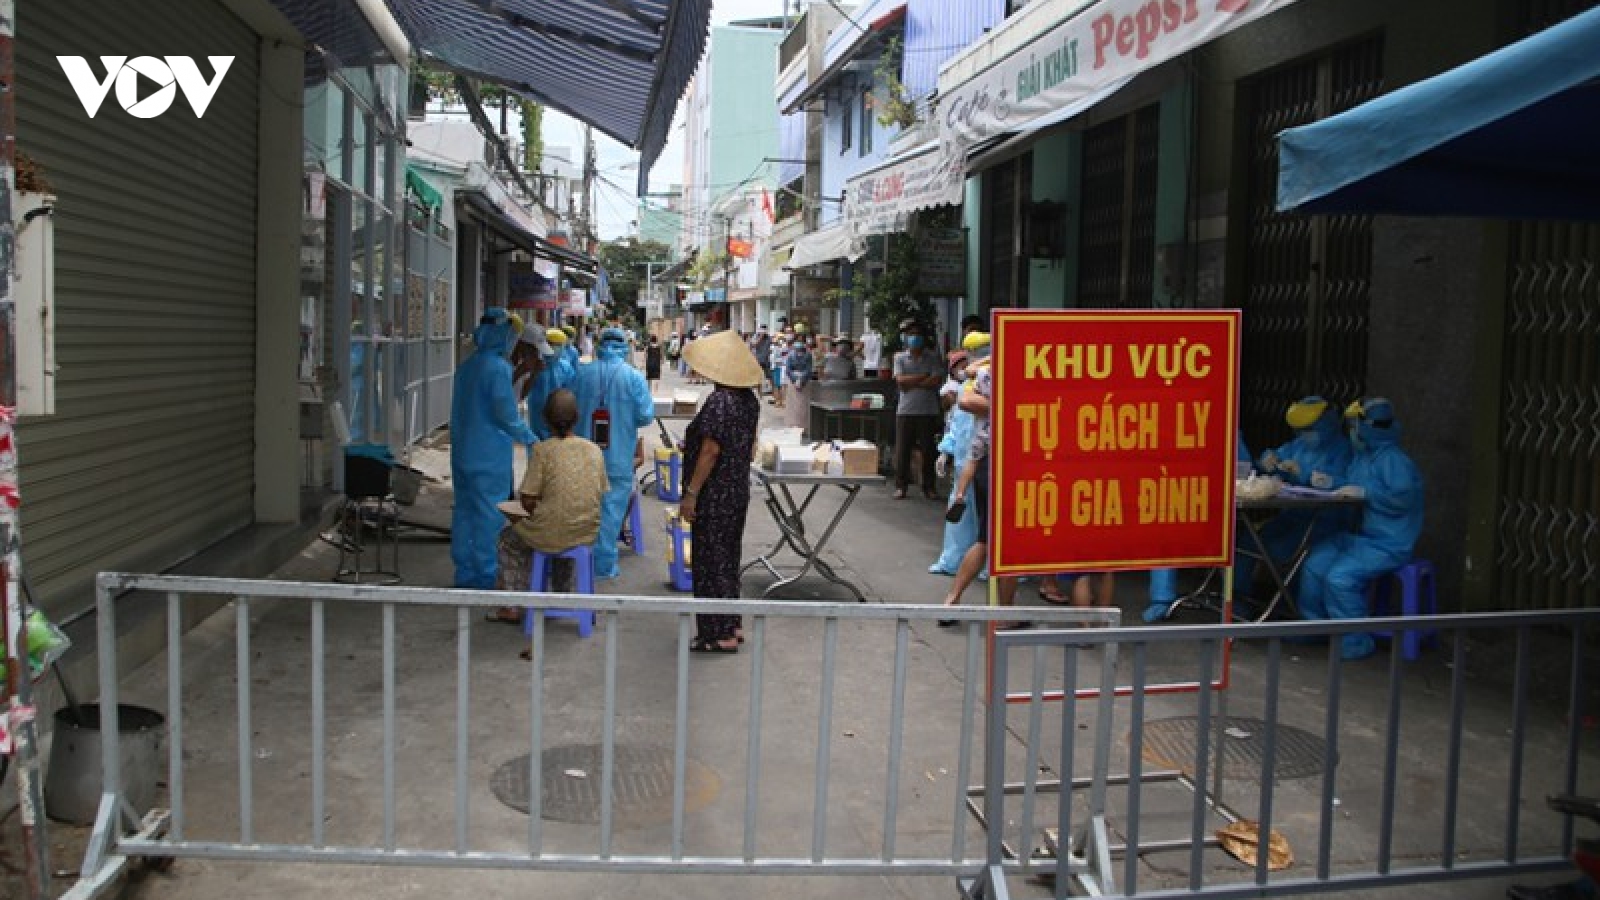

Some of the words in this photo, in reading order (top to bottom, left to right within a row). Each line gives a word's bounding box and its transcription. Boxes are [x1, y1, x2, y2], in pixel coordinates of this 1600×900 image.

[1023, 343, 1113, 380] KHU
[1127, 337, 1212, 386] VỰC
[1015, 396, 1062, 461] TỰ
[1077, 393, 1159, 451] CÁCH
[1175, 401, 1211, 449] LY
[1014, 471, 1060, 536] HỘ
[1071, 479, 1123, 527] GIA
[1137, 465, 1209, 525] ĐÌNH
